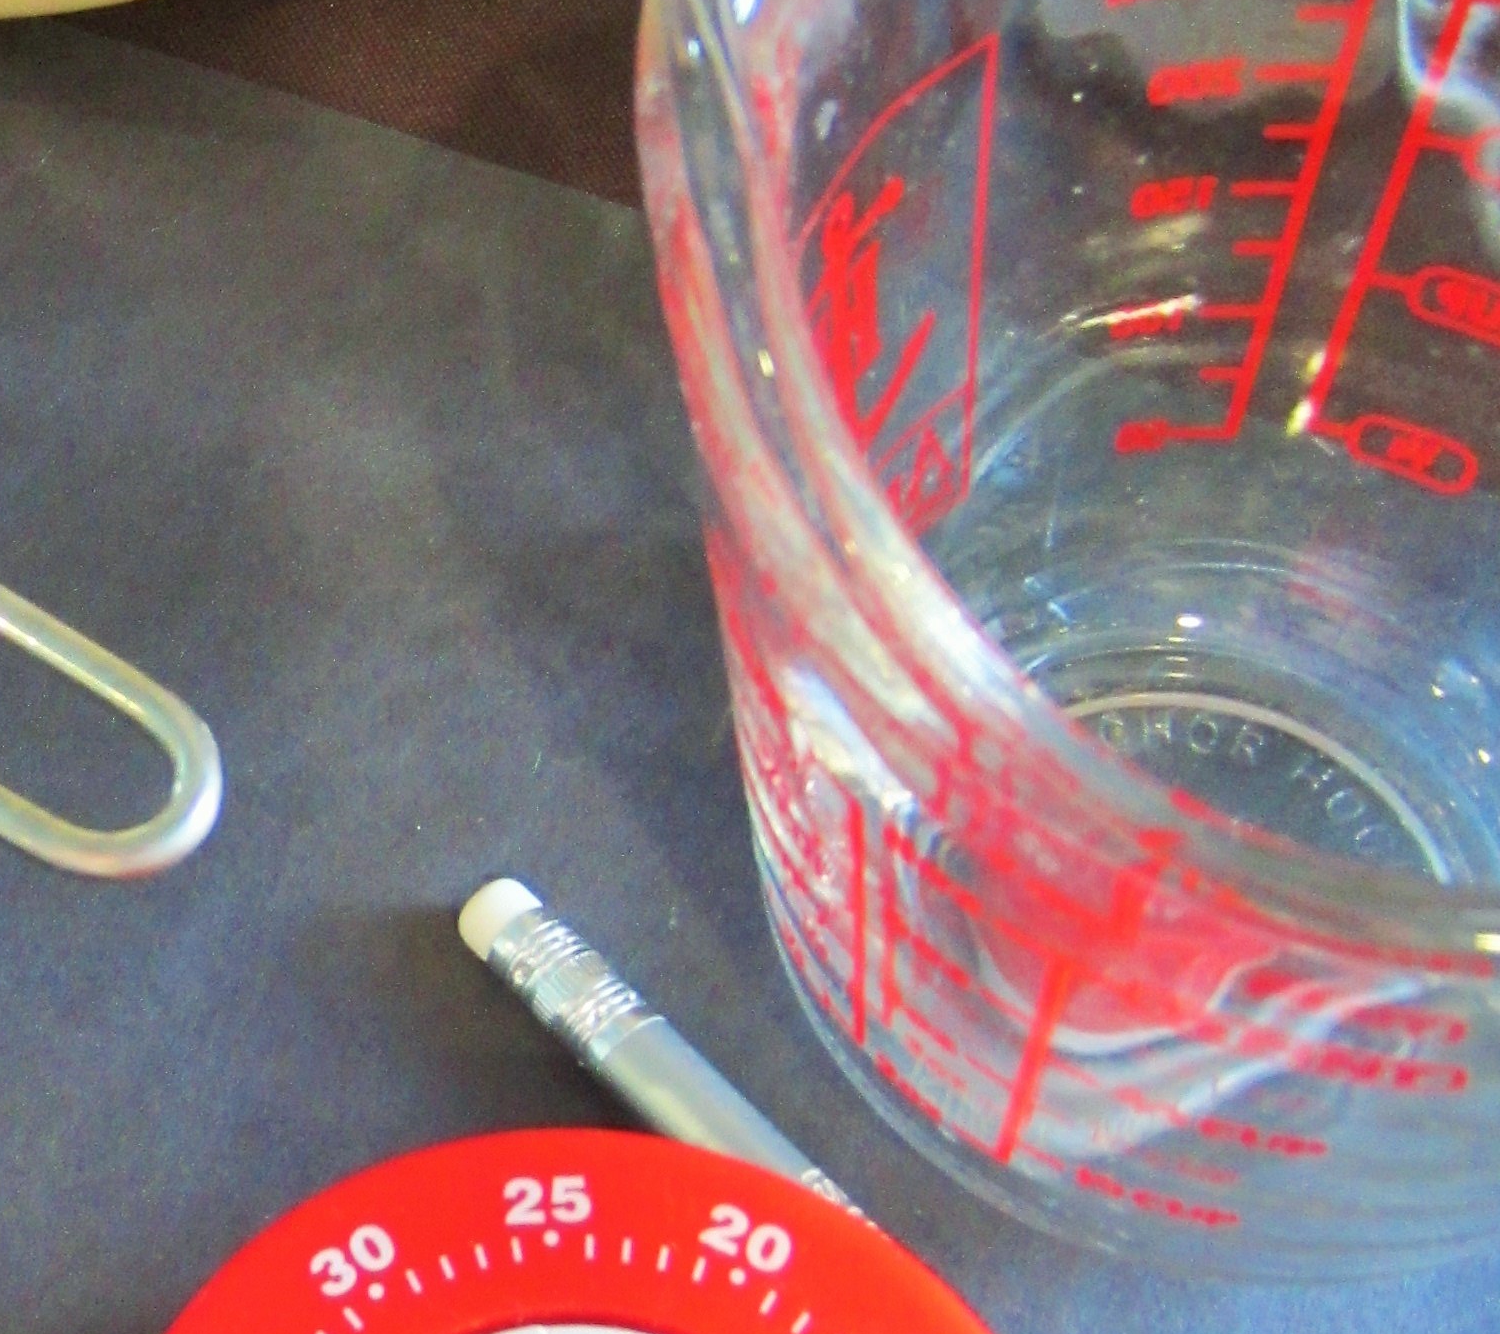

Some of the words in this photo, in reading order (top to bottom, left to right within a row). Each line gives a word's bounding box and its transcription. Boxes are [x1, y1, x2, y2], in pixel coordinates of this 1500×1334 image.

[503, 1174, 593, 1225] 25
[308, 1224, 396, 1298] 30
[699, 1203, 793, 1274] 20
